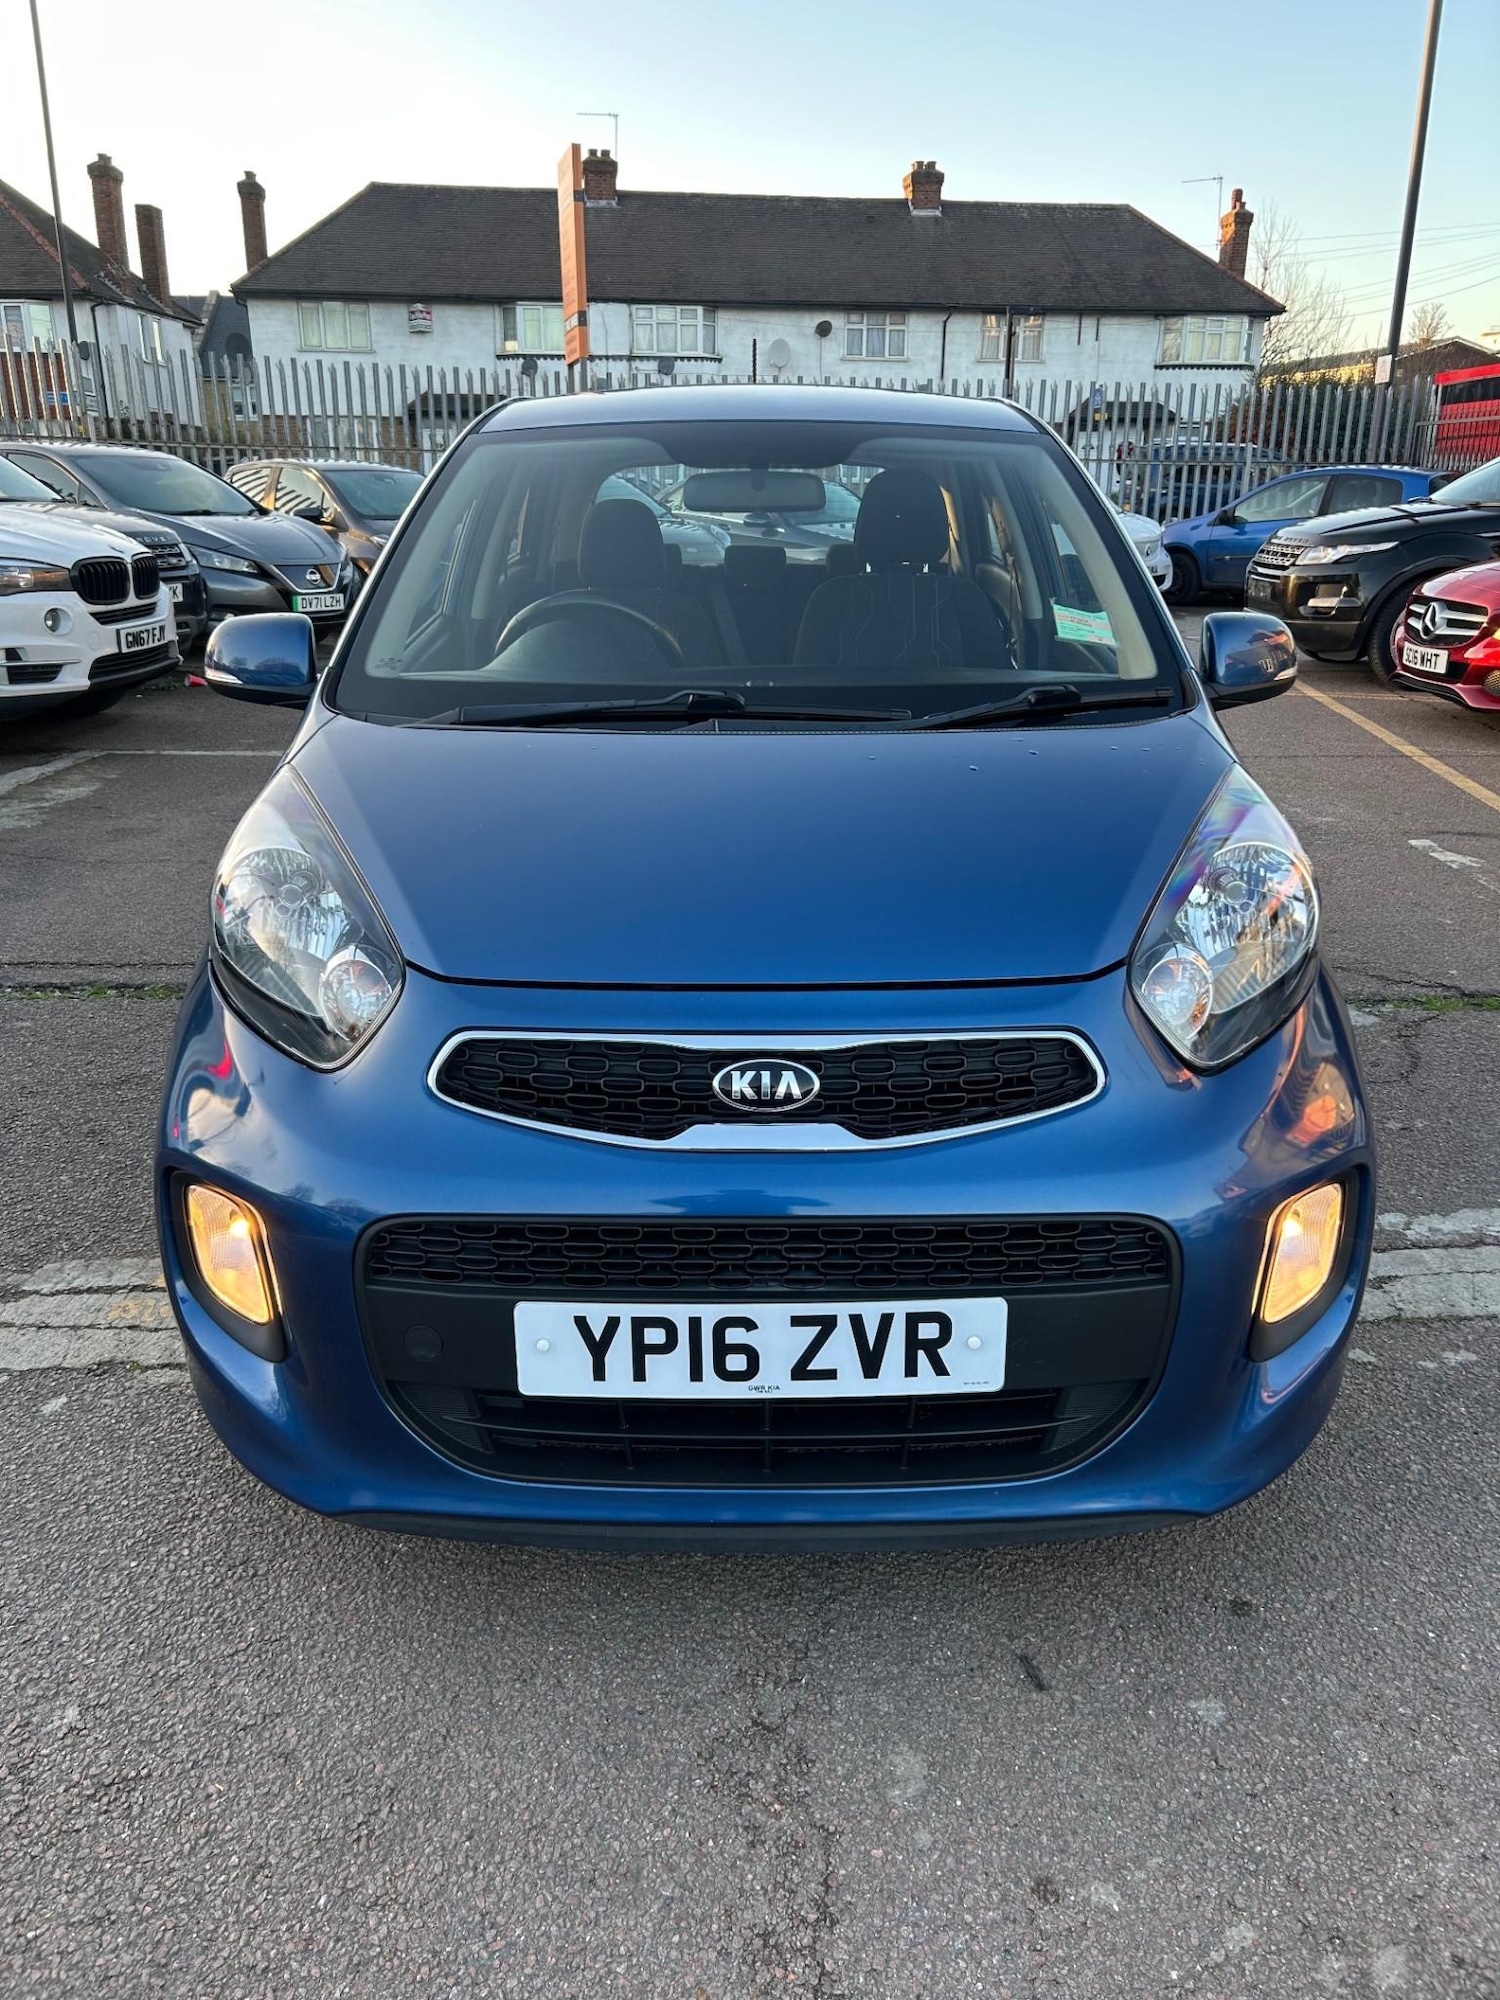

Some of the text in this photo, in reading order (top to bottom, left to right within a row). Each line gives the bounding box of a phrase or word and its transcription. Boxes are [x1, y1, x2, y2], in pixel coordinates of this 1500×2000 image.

[301, 595, 341, 609] DV71 LZH
[125, 624, 166, 649] GN67 FJY
[1405, 646, 1440, 670] SC16 WHT
[730, 1070, 802, 1100] KIA
[573, 1311, 953, 1382] YP16 ZVR
